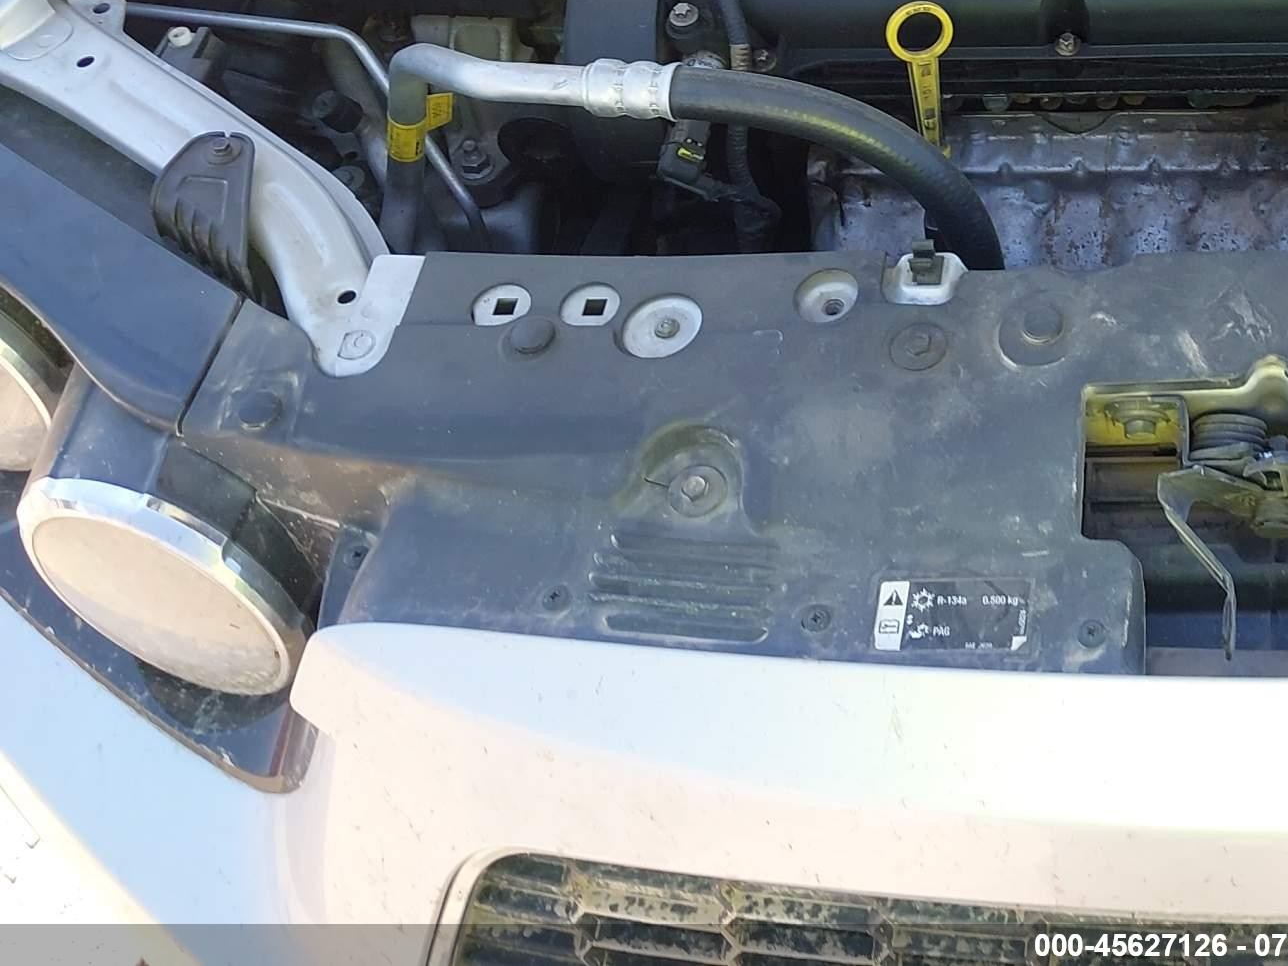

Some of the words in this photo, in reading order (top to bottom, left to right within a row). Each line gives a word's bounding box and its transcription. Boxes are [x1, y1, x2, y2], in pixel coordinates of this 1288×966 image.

[937, 595, 968, 606] R-134a
[1007, 595, 1019, 607] kg
[932, 624, 951, 637] PAG
